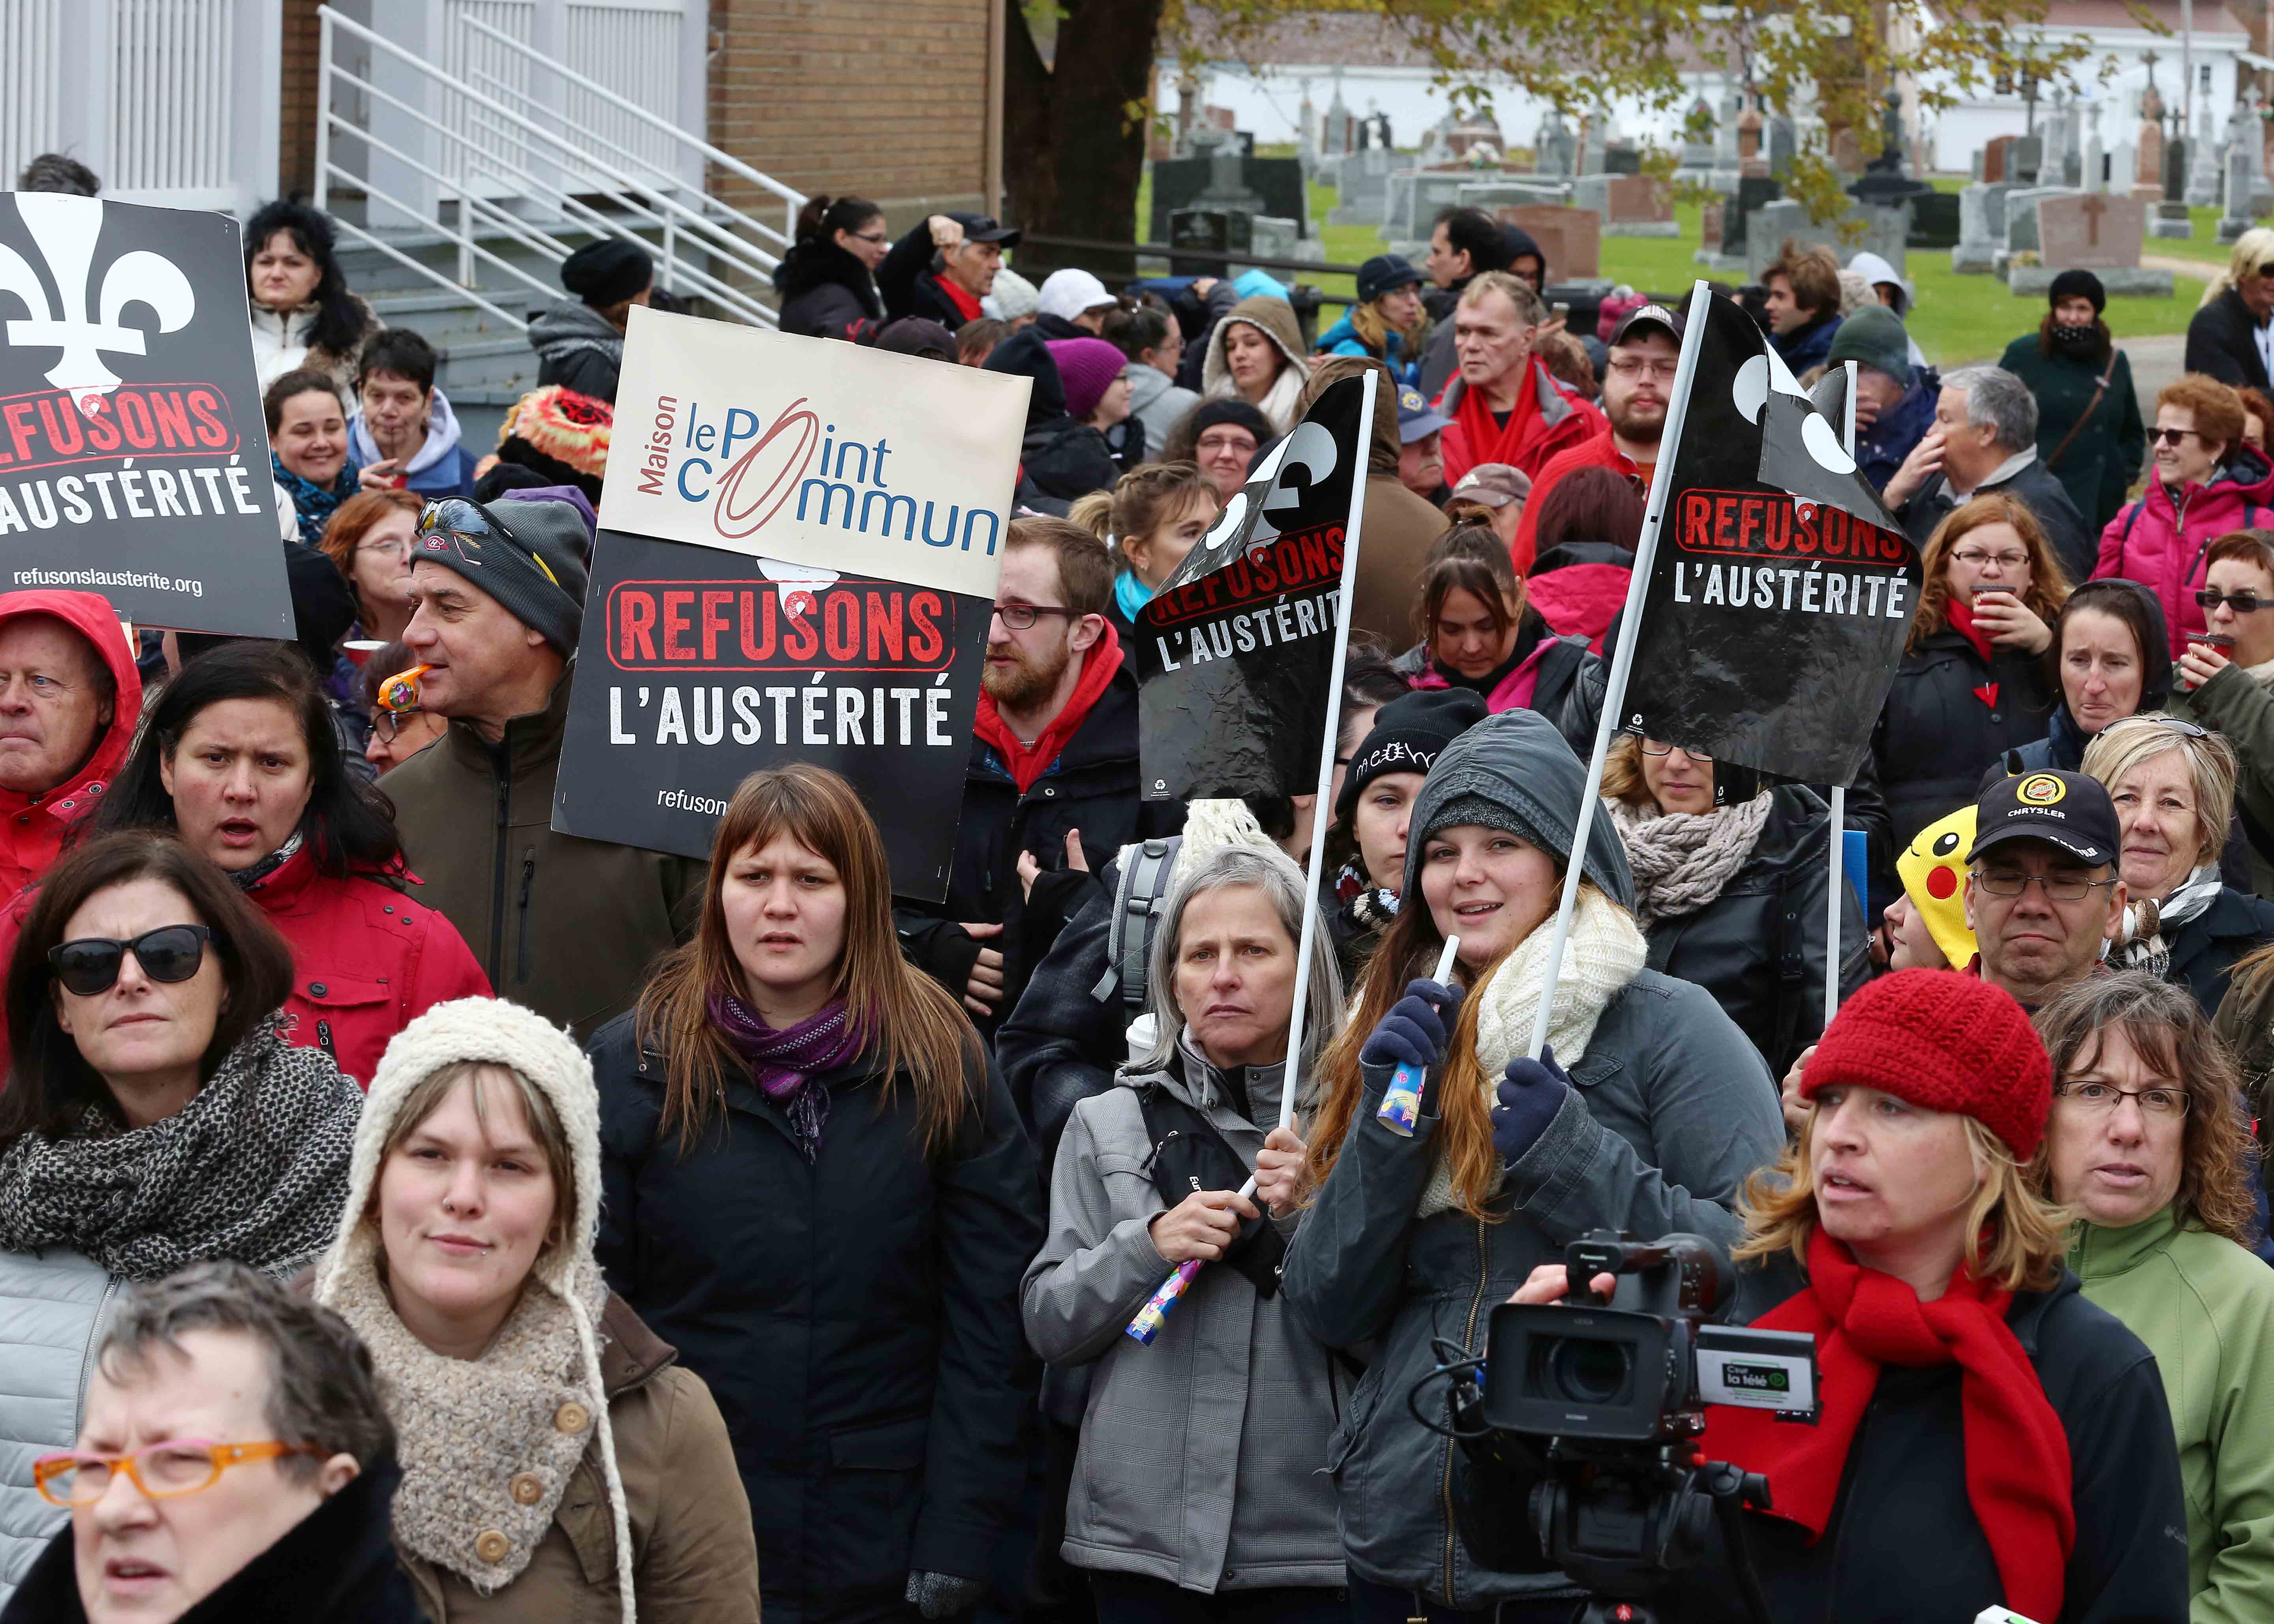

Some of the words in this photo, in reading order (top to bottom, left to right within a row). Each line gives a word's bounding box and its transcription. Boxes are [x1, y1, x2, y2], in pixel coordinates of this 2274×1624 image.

[637, 395, 677, 495] Maison
[685, 402, 715, 451] le
[13, 568, 203, 597] refusonslausterite.org
[620, 591, 944, 662] REFUSONS
[657, 789, 731, 816] refuson
[2008, 806, 2066, 819] CHRYSLER
